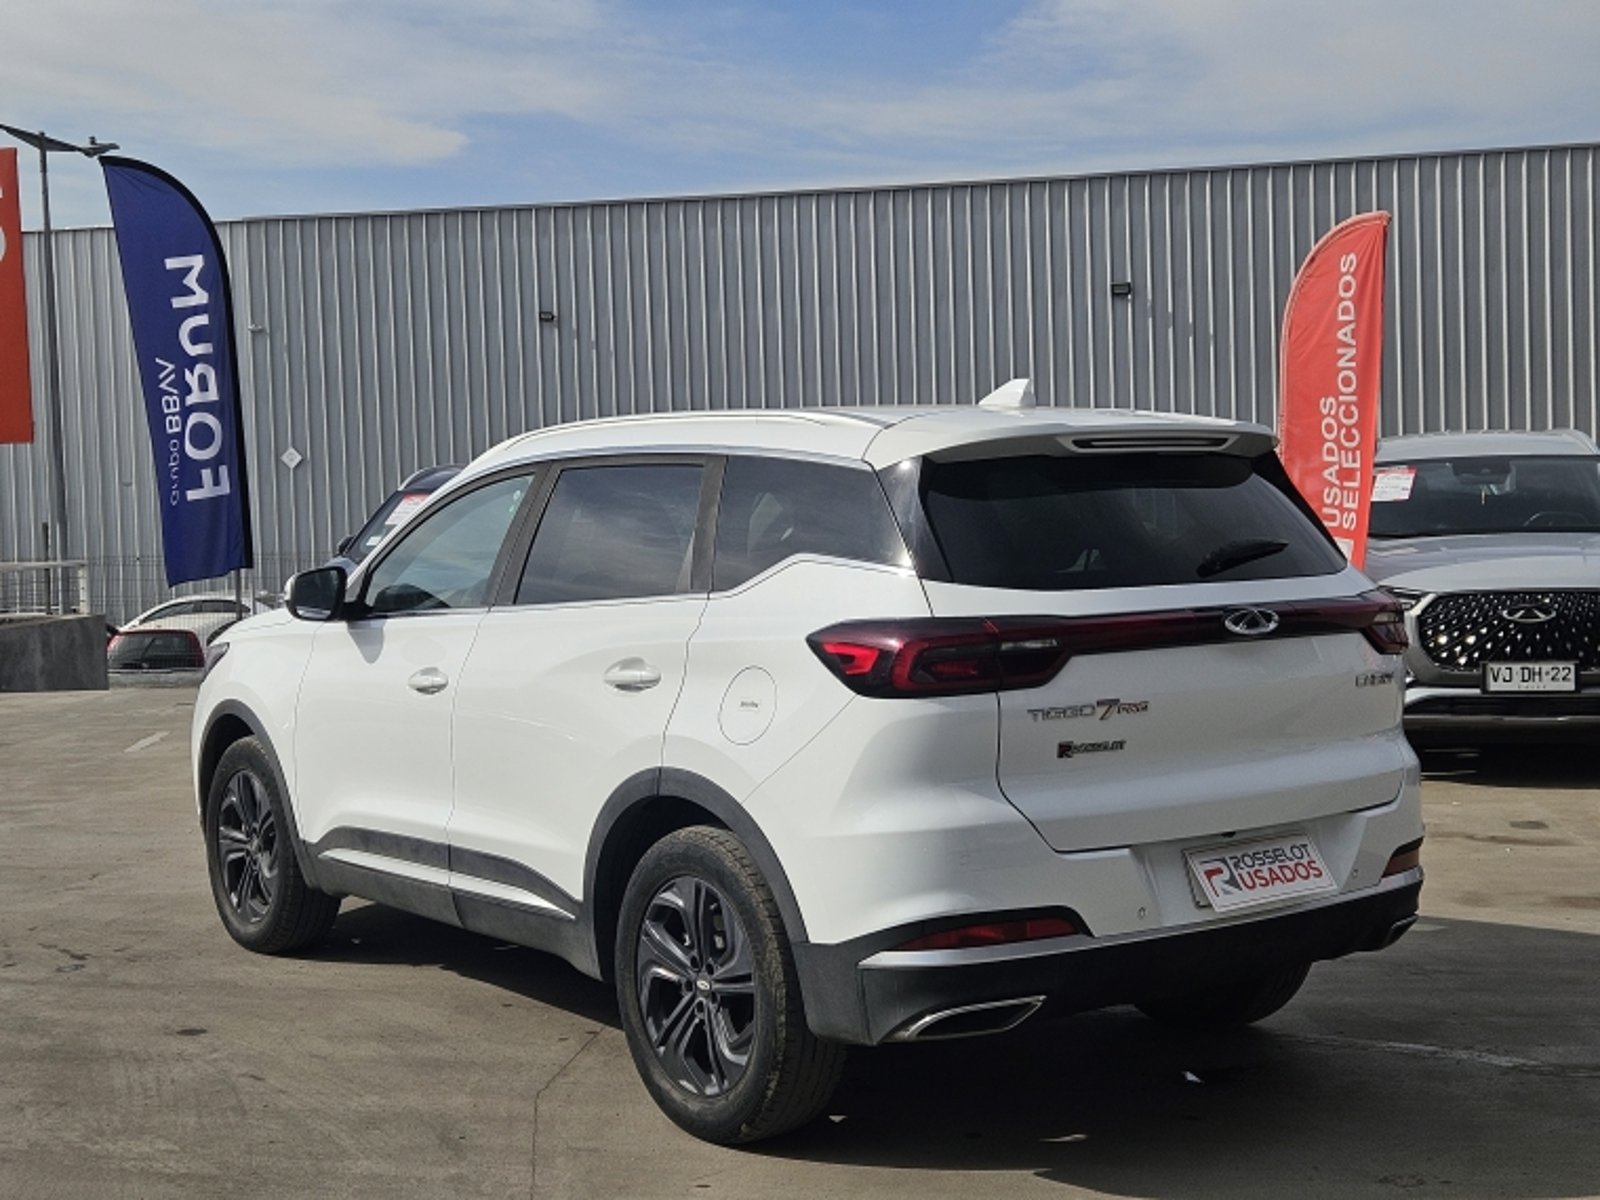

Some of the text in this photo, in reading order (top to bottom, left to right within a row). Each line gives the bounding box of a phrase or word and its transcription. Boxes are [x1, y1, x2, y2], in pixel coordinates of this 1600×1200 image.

[1337, 252, 1361, 530] SELECCIONADOS
[1320, 396, 1340, 528] USADOS
[1096, 698, 1120, 720] 7
[1229, 844, 1311, 871] ROSSELOT
[1238, 860, 1323, 890] USADOS
